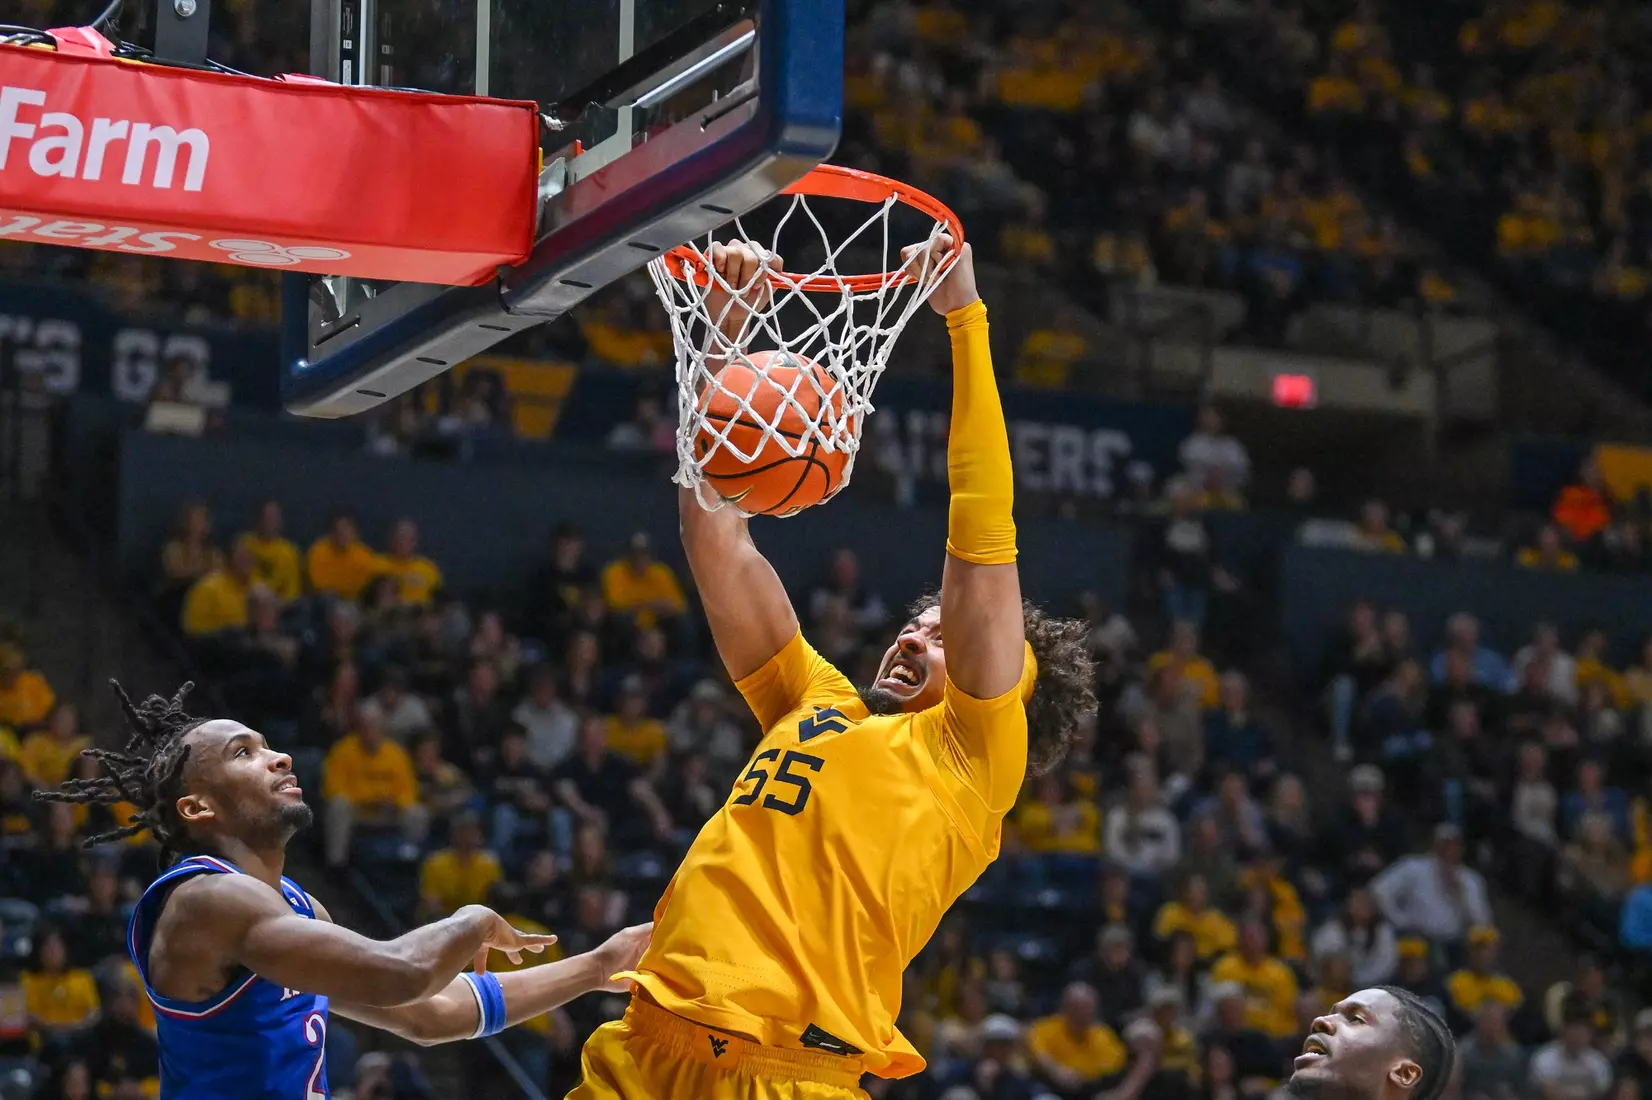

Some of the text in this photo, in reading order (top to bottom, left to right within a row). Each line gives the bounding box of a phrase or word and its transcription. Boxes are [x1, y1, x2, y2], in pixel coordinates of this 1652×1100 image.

[0, 86, 210, 192] Farm
[0, 215, 203, 253] Stat
[732, 748, 825, 816] 55
